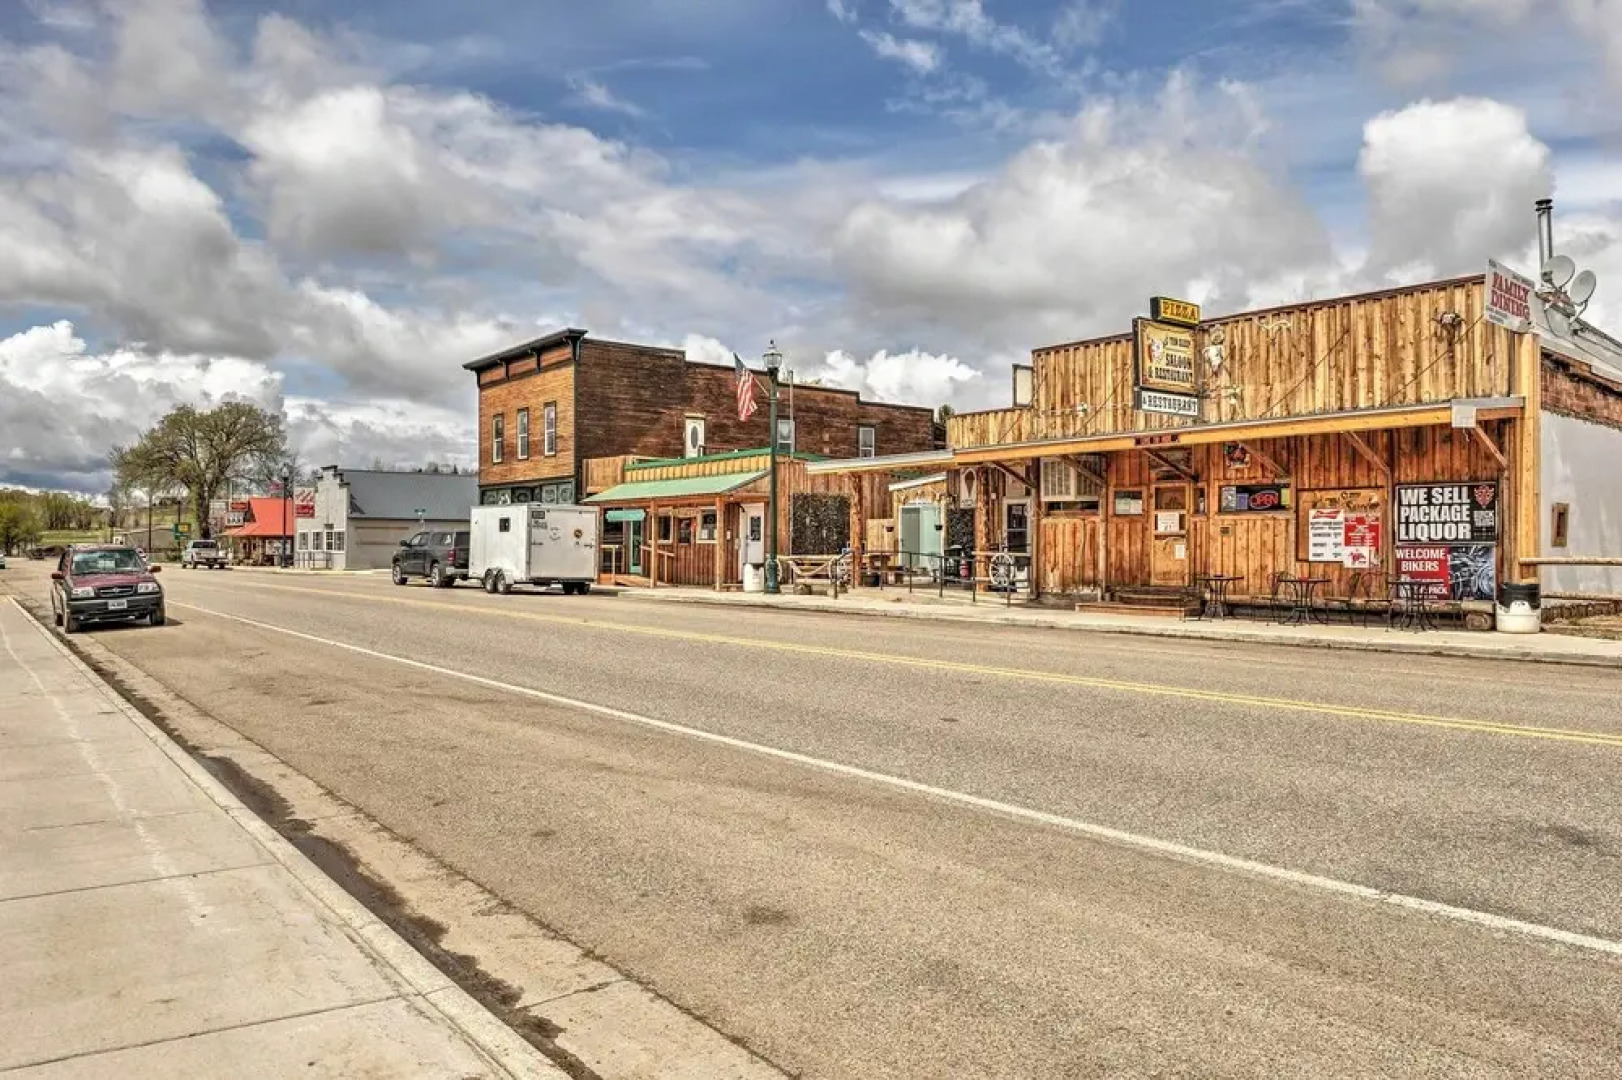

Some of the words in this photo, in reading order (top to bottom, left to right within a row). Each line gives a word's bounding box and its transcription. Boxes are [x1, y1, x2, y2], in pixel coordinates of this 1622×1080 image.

[1492, 272, 1530, 303] FAMILY
[1162, 301, 1197, 321] PIZZA
[1490, 289, 1530, 321] DINING
[1165, 352, 1192, 370] SALOON
[1154, 367, 1193, 384] RESTAURANT
[1147, 394, 1196, 413] RESTAURANT
[1251, 492, 1278, 508] OPEN
[1400, 487, 1428, 505] WE
[1431, 486, 1471, 504] SELL
[1400, 504, 1471, 523] PACKAGE
[1399, 522, 1472, 543] LIQUOR
[1394, 547, 1446, 559] WELCOME
[1400, 560, 1440, 572] BIKERS
